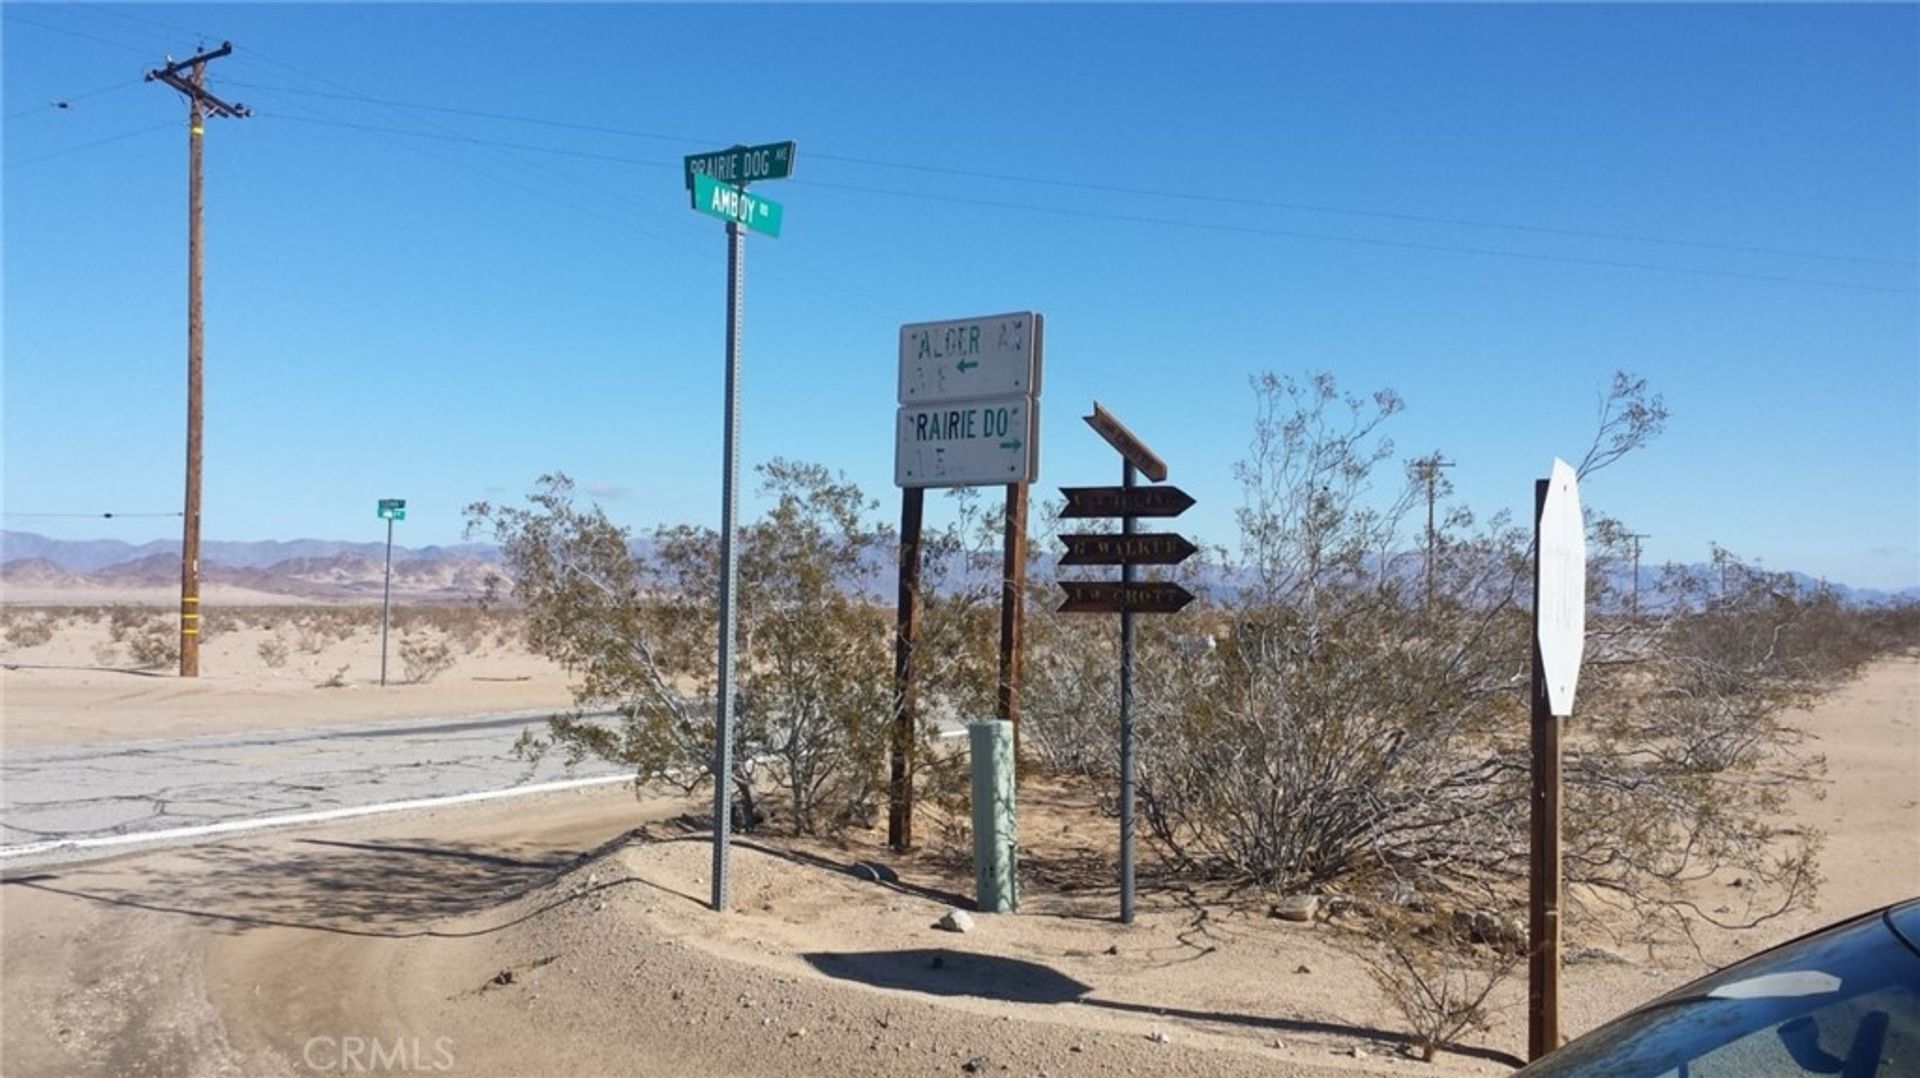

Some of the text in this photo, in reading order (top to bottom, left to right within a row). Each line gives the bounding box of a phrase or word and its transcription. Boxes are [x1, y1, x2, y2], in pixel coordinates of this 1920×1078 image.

[743, 150, 770, 178] DOG
[711, 186, 756, 224] AMBOY
[906, 404, 1016, 442] RAIRIE DO
